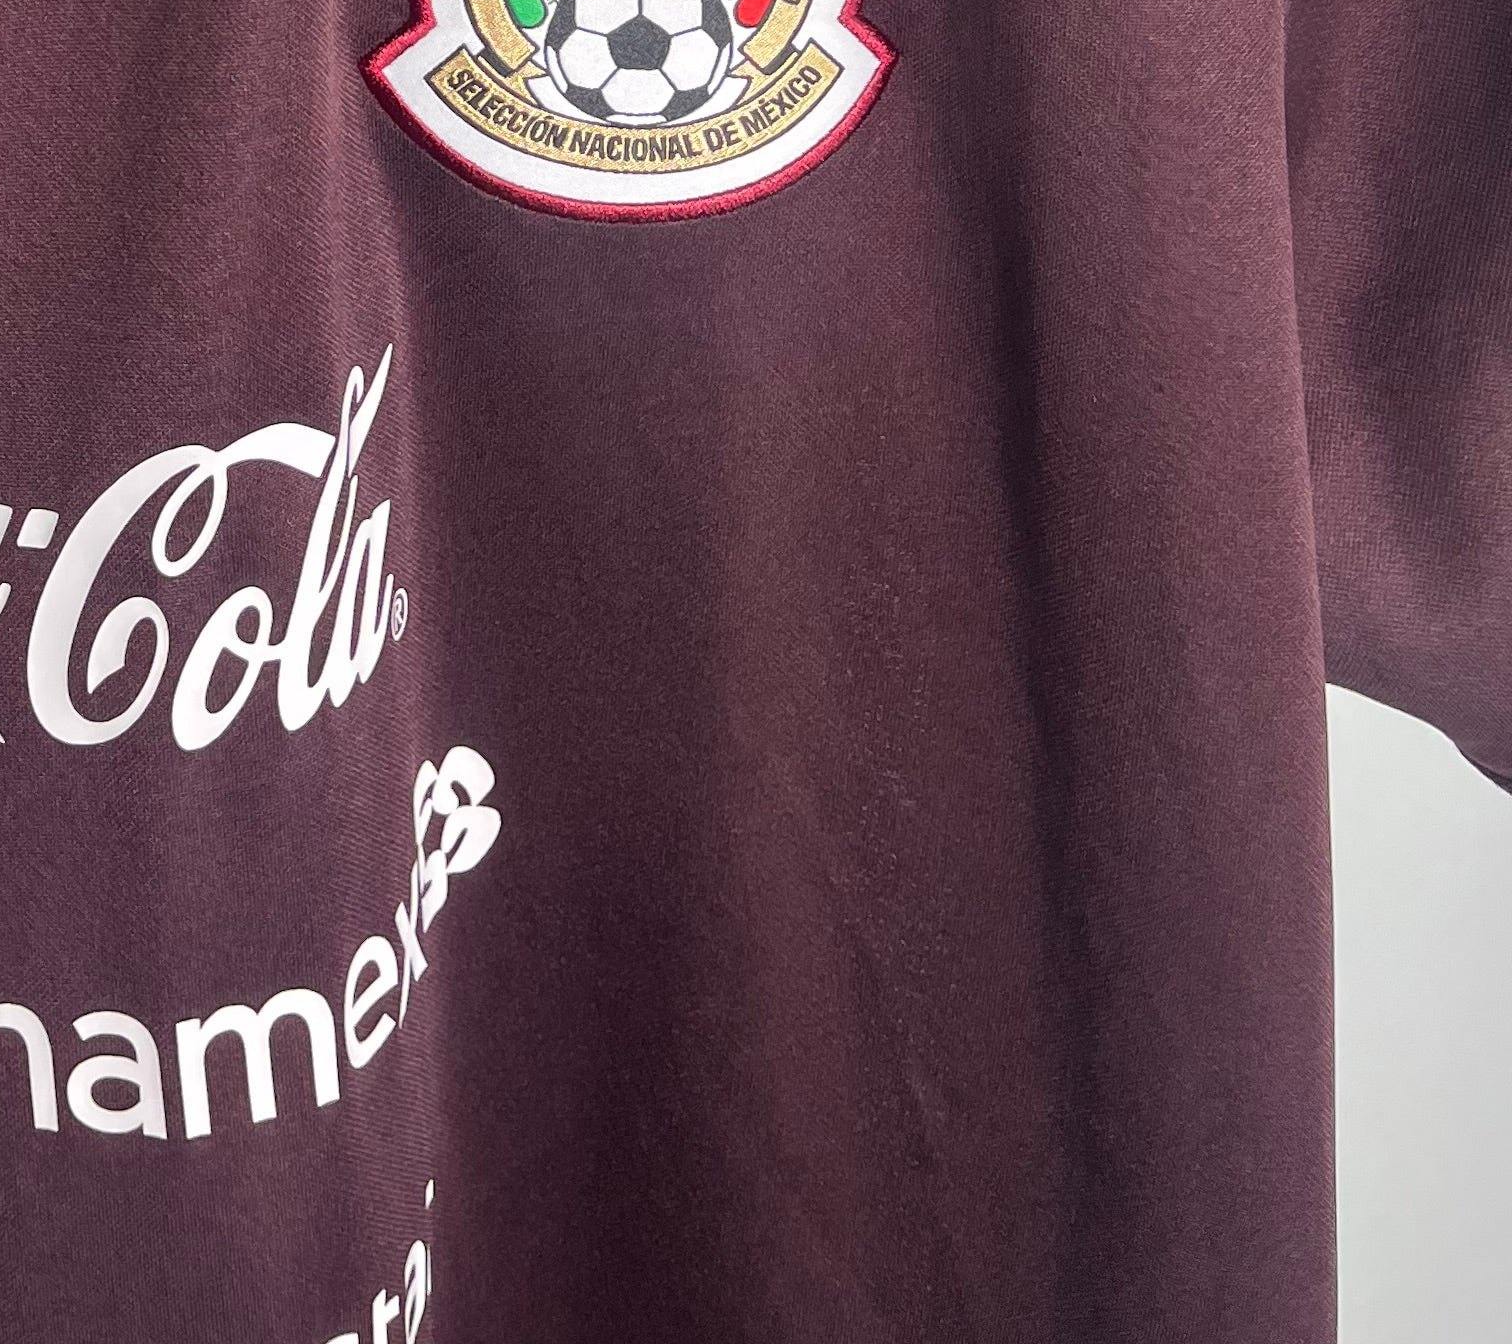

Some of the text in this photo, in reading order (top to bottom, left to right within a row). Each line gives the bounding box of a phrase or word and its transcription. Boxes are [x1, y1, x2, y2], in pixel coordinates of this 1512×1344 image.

[446, 62, 823, 164] SELECCIÓN NACIONAL DE MÉXICO
